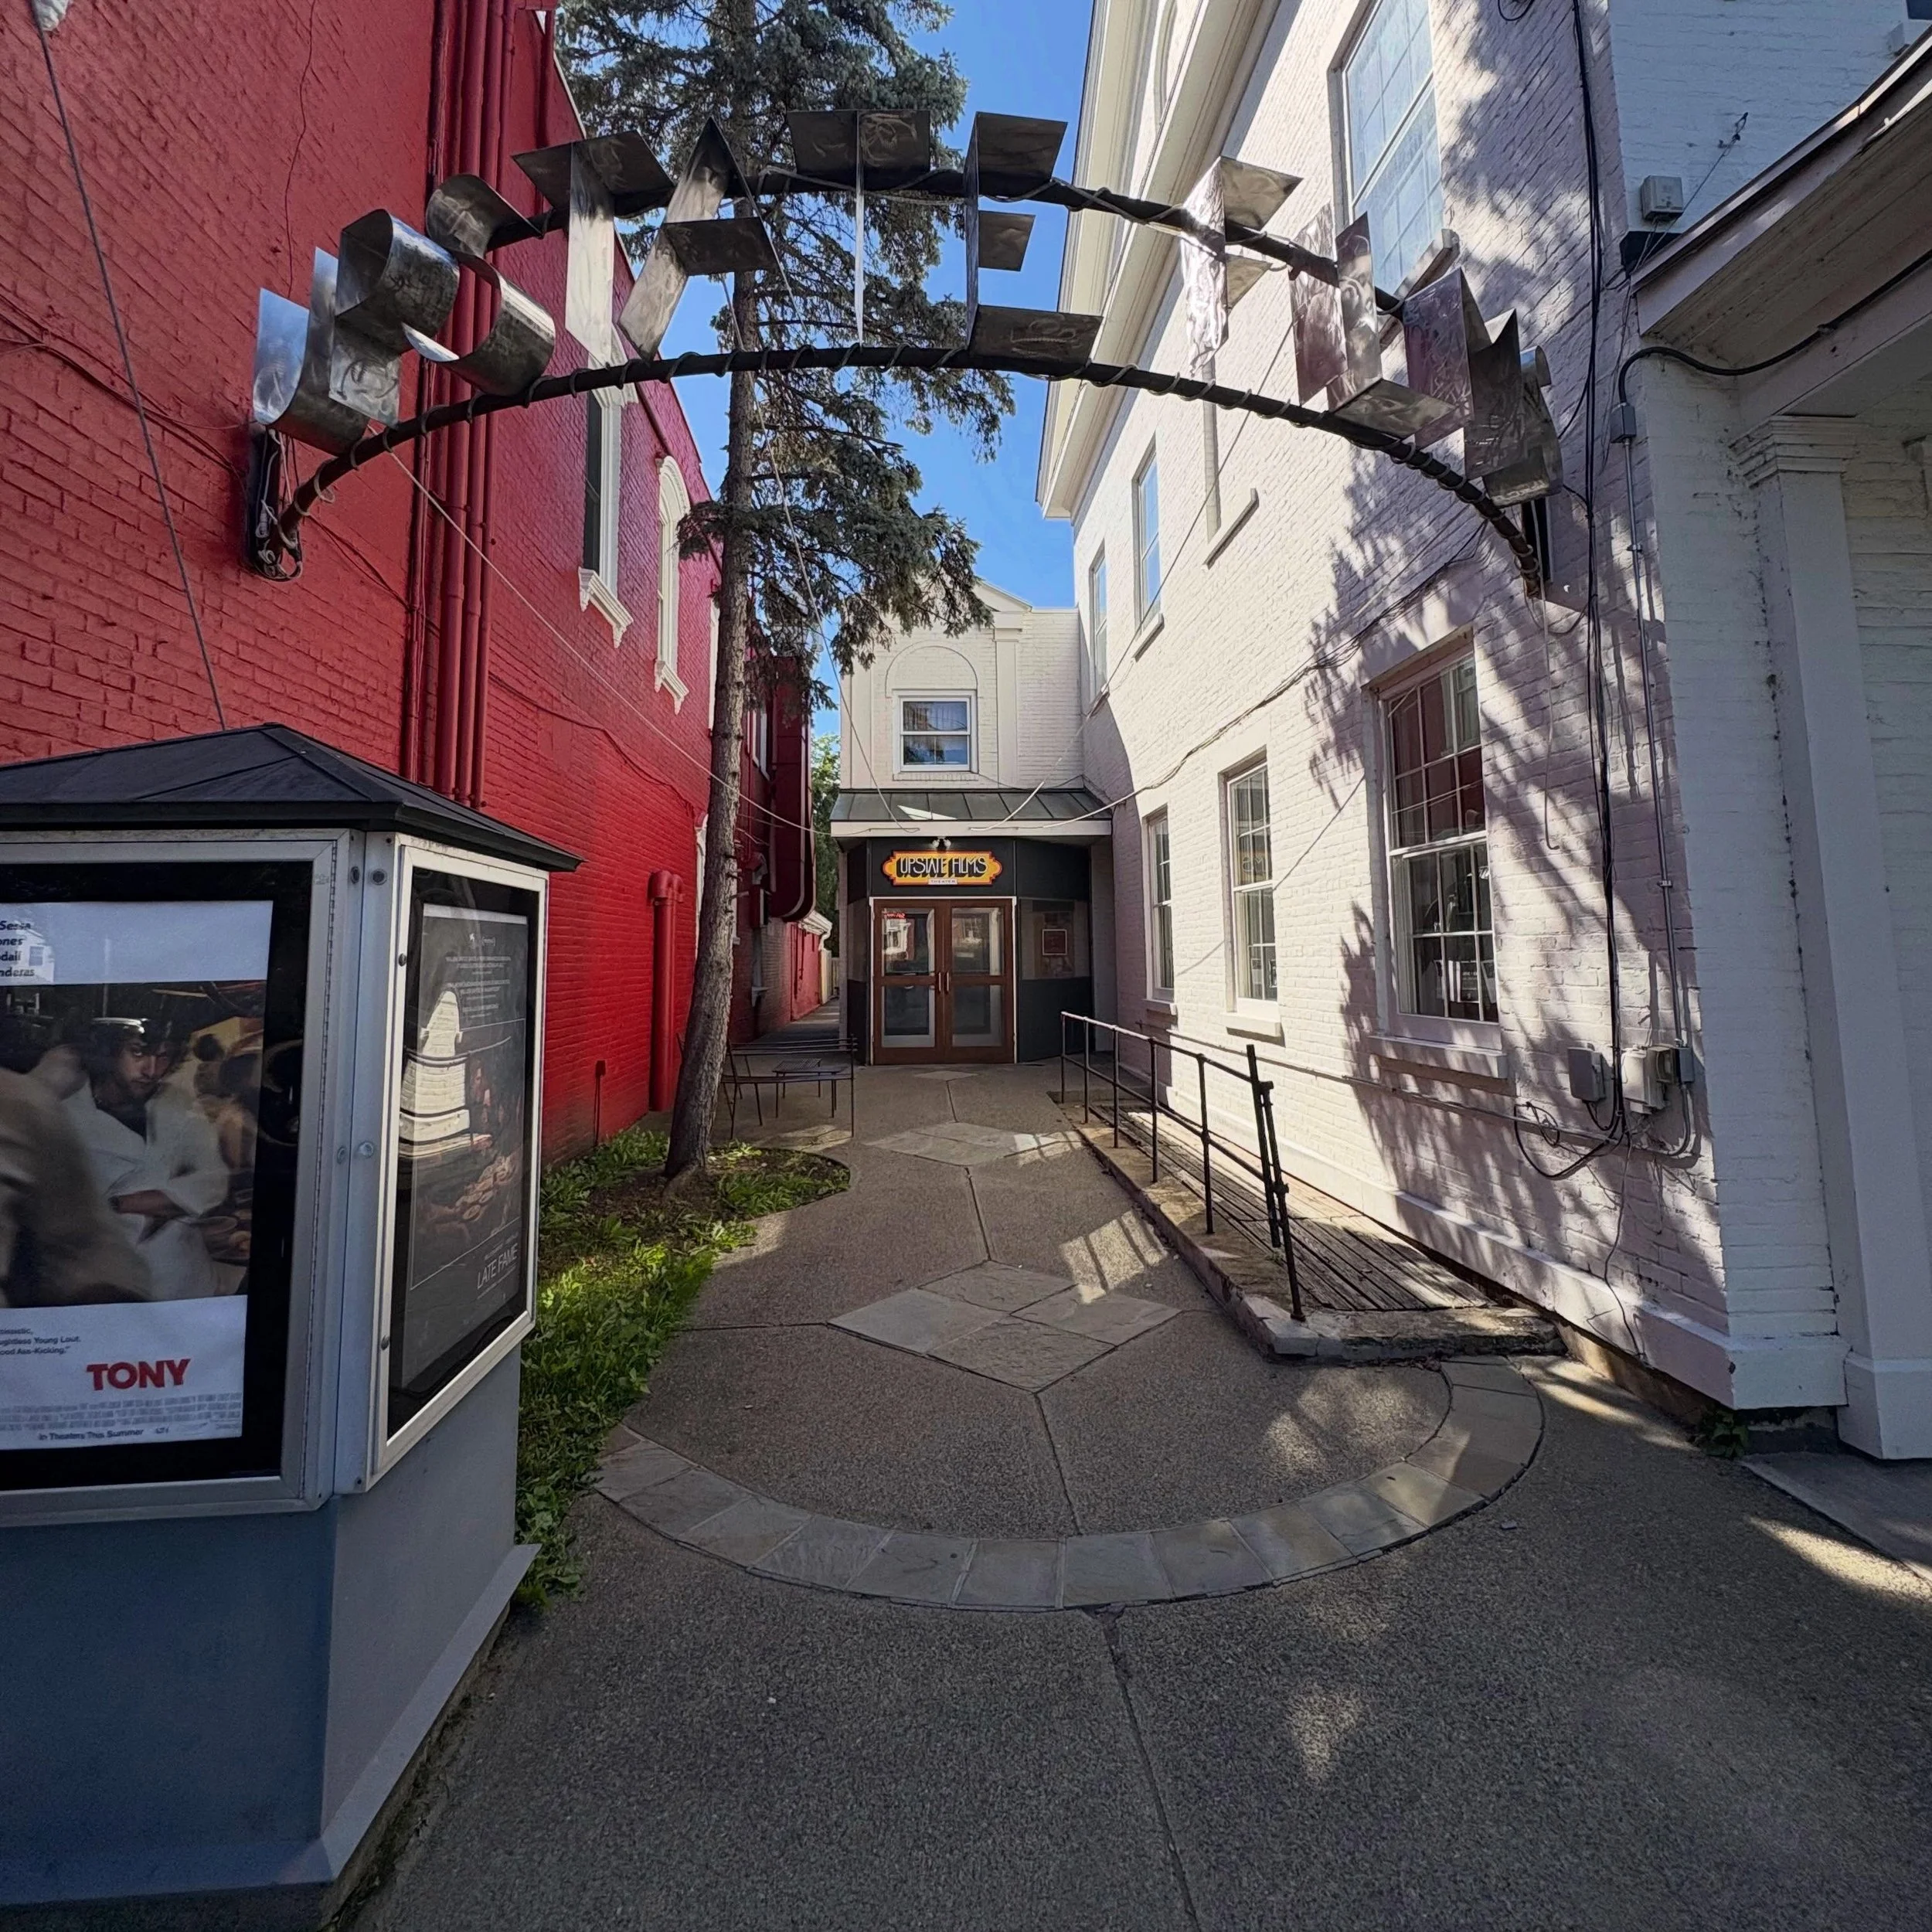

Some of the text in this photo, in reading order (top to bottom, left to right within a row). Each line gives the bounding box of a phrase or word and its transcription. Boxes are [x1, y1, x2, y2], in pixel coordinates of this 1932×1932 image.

[900, 855, 988, 874] UPSTATE FILMS
[477, 1258, 498, 1290] LATE
[497, 1242, 519, 1274] FAME
[86, 1359, 192, 1391] TONY
[107, 1429, 145, 1437] Summer
